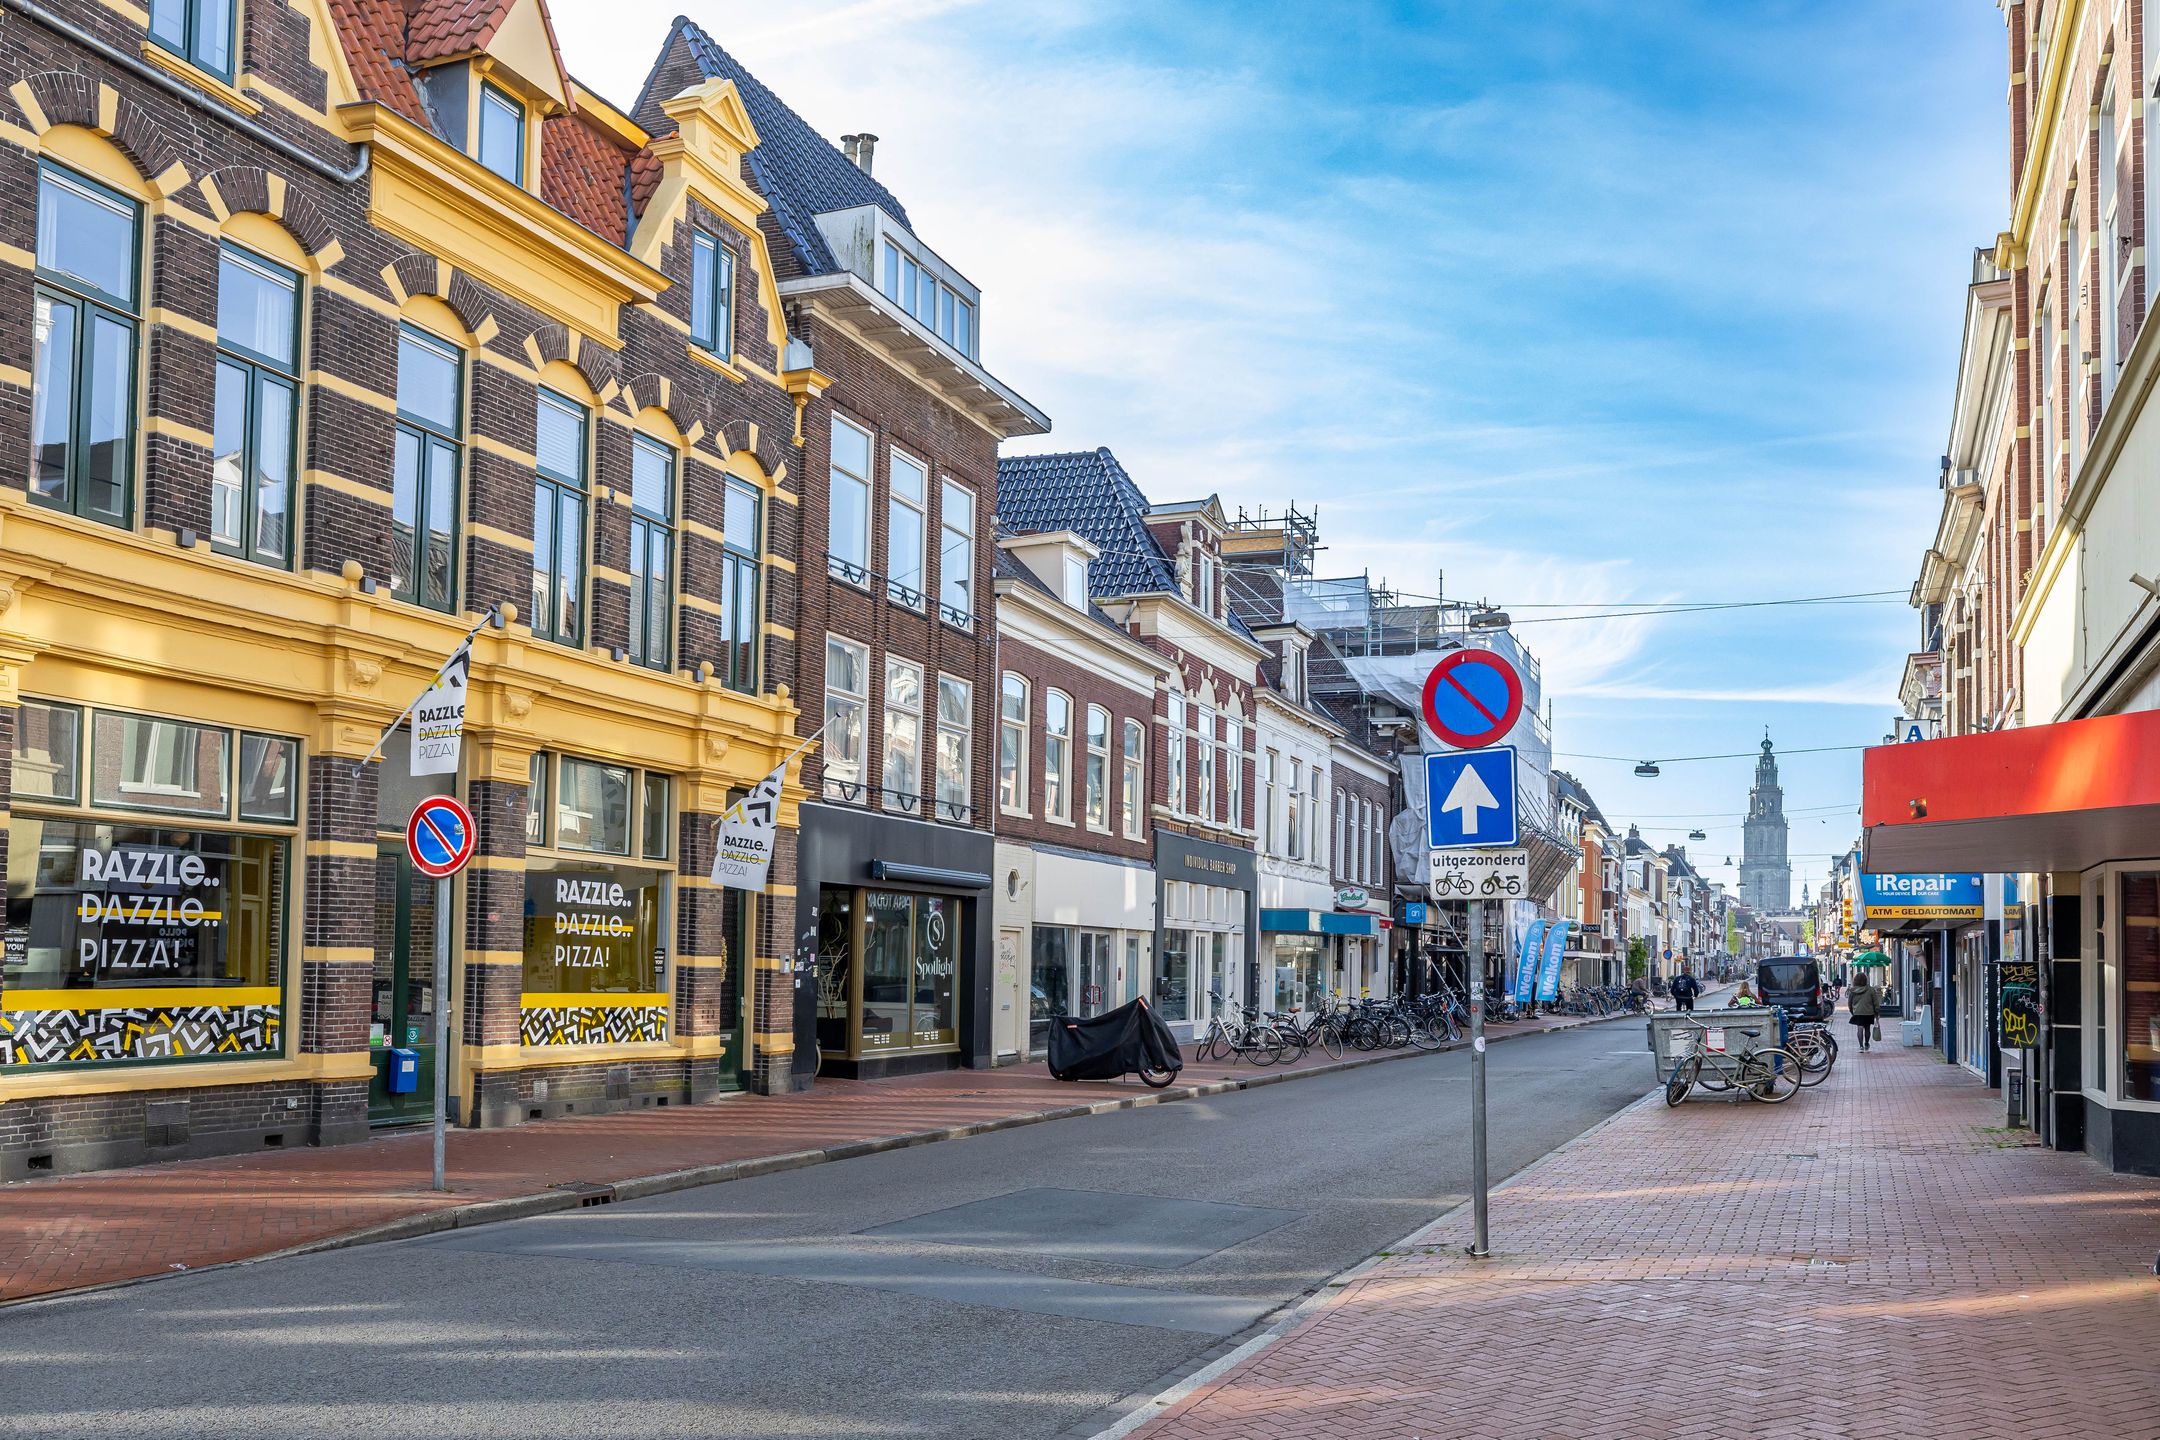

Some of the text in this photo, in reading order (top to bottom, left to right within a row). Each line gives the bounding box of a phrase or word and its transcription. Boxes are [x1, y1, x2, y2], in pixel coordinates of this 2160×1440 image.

[419, 743, 455, 759] PIZZA!
[719, 862, 748, 876] PIZZA!
[1210, 859, 1225, 873] BARBER
[1226, 862, 1237, 875] SHOP
[1433, 854, 1526, 870] uitgezonderd
[1876, 874, 1957, 896] iRepair
[80, 938, 181, 968] PIZZA!
[555, 945, 609, 968] PIZZA!
[1520, 941, 1538, 996] Welkom
[1542, 943, 1562, 996] Welkom
